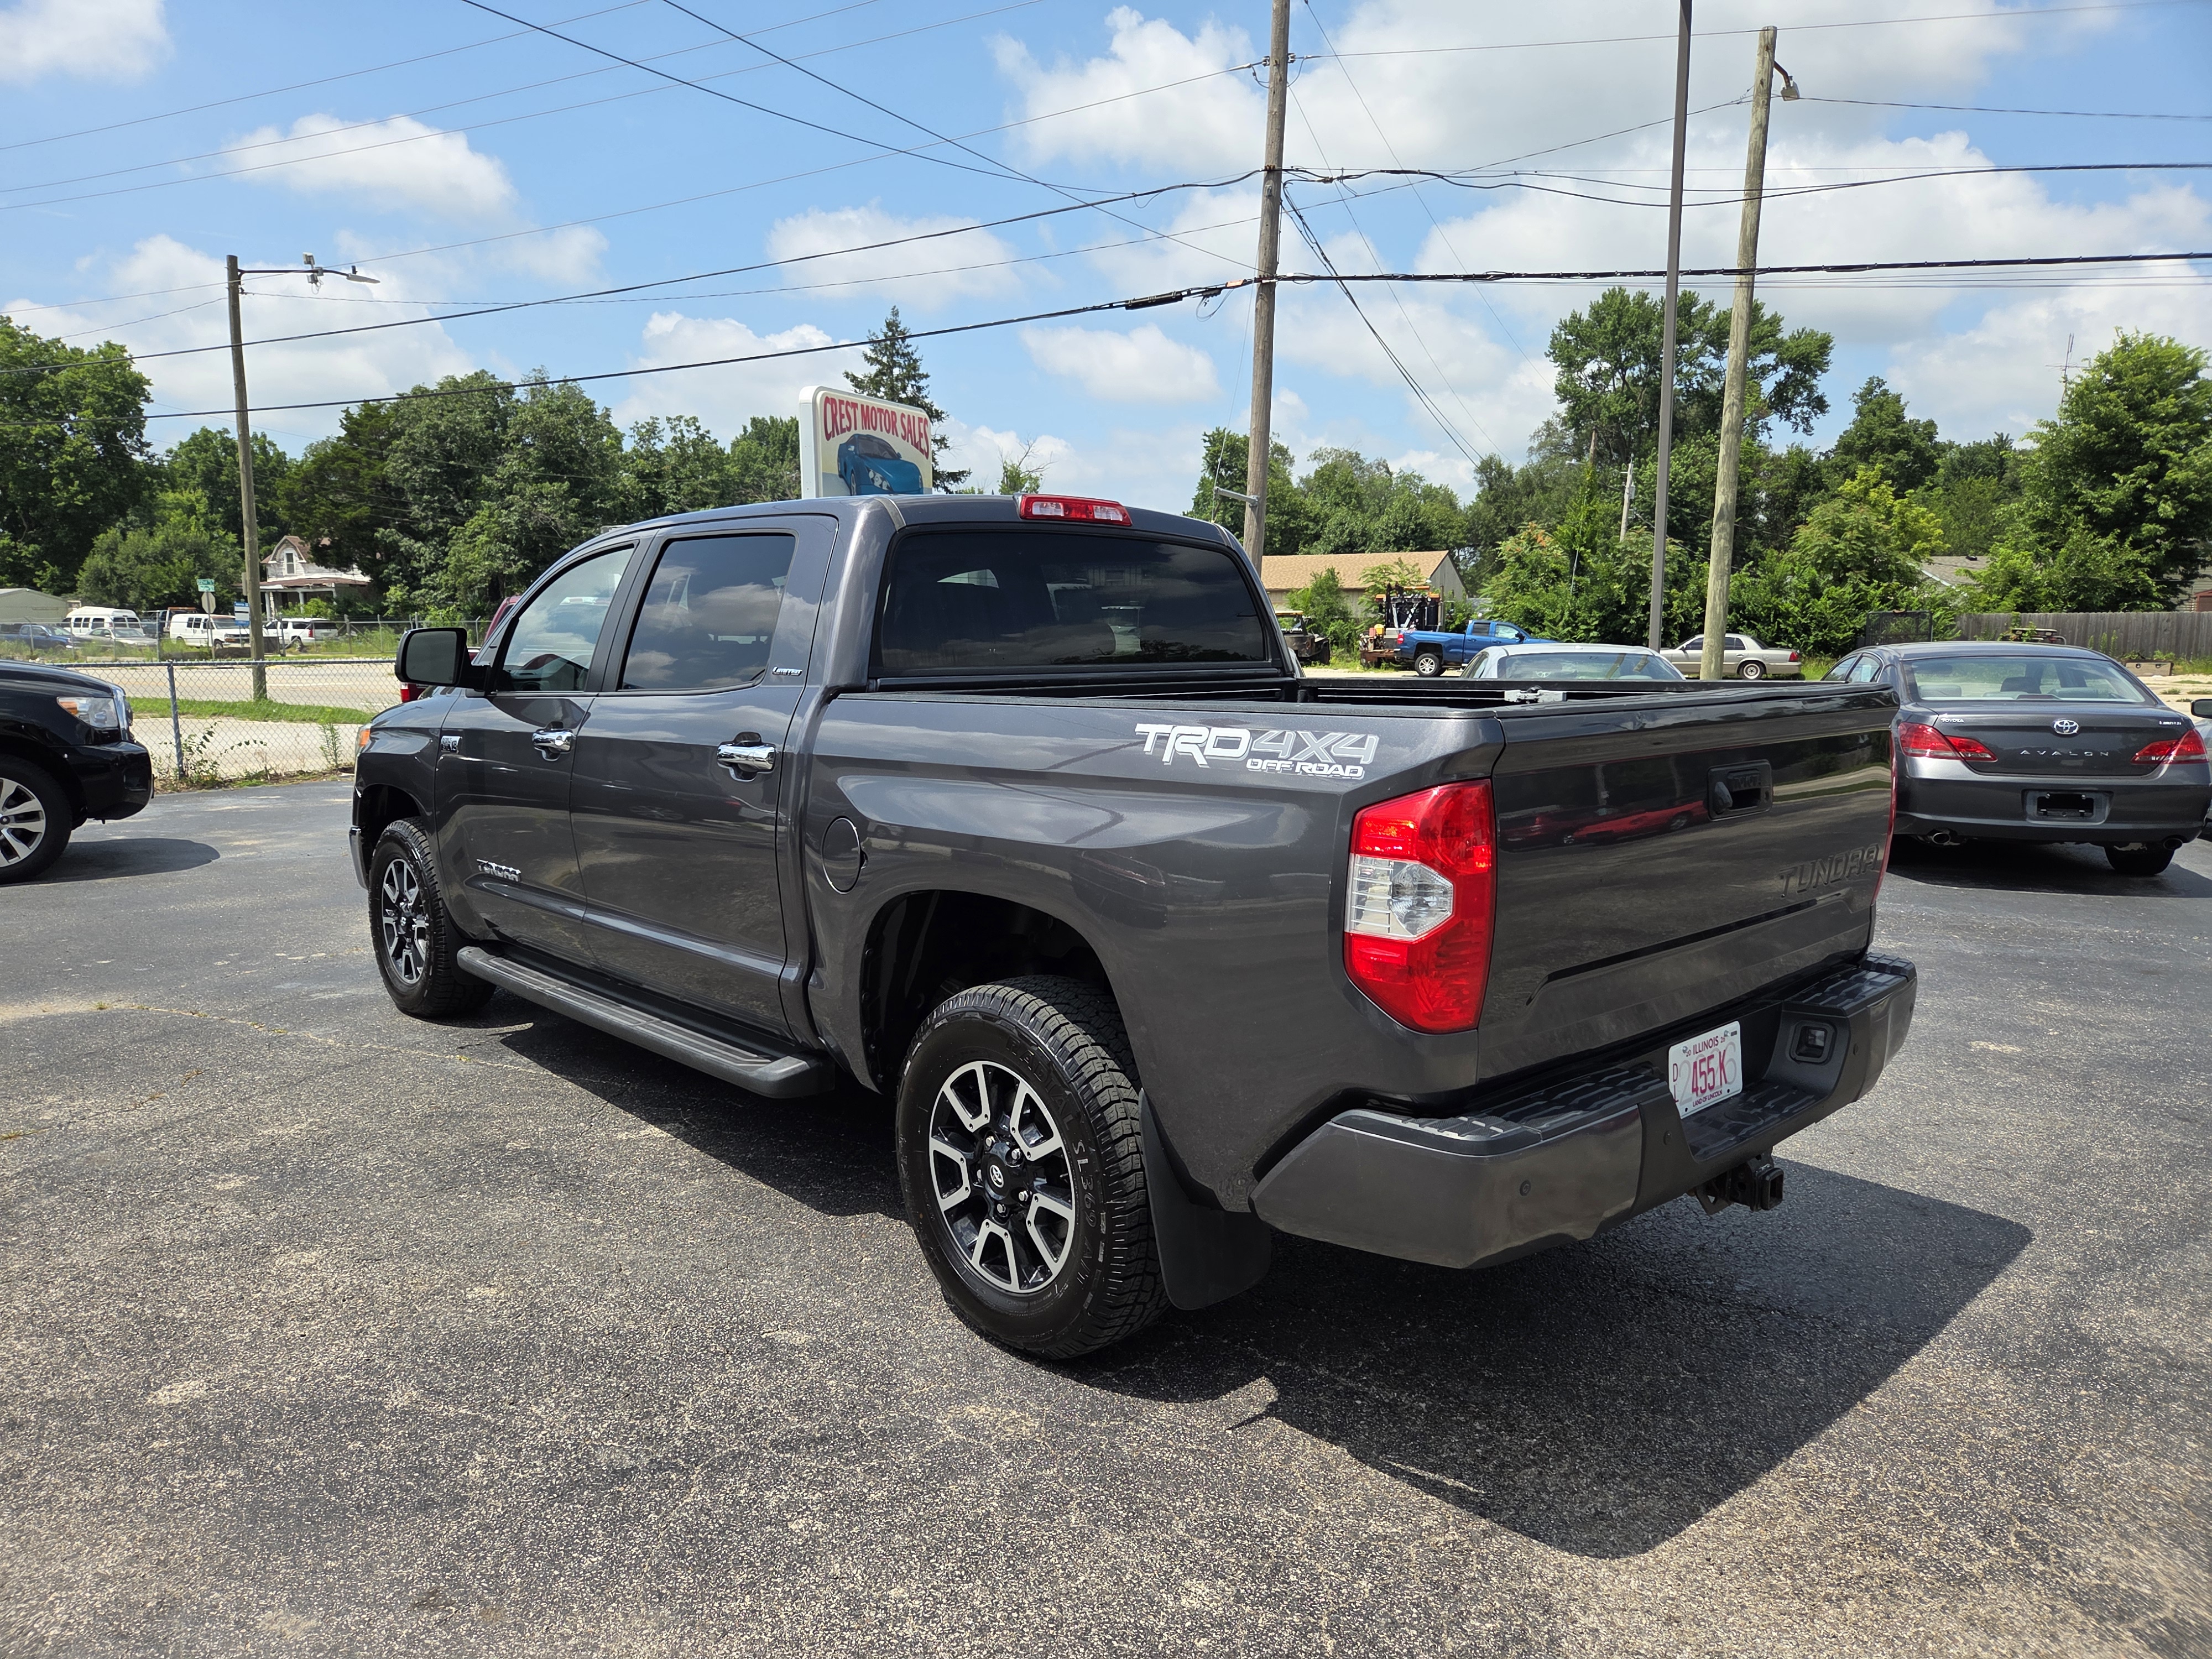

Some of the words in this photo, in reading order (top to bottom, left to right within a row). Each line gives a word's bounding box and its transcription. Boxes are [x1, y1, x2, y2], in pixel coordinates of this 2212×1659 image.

[823, 396, 858, 441] CREST
[860, 404, 899, 437] MOTOR
[900, 413, 929, 460] SALES
[1134, 723, 1253, 768] TRD
[1246, 758, 1294, 774] OFF
[1295, 761, 1365, 780] ROAD
[1779, 842, 1880, 898] TUNDRA
[1693, 1036, 1719, 1055] ILLINOIS
[1692, 1054, 1715, 1097] 455
[1719, 1049, 1728, 1087] K
[1692, 1098, 1702, 1107] LAND
[1708, 1089, 1723, 1101] LINCOLN
[1006, 1035, 1074, 1131] RADIAL
[1072, 1139, 1097, 1228] SL369
